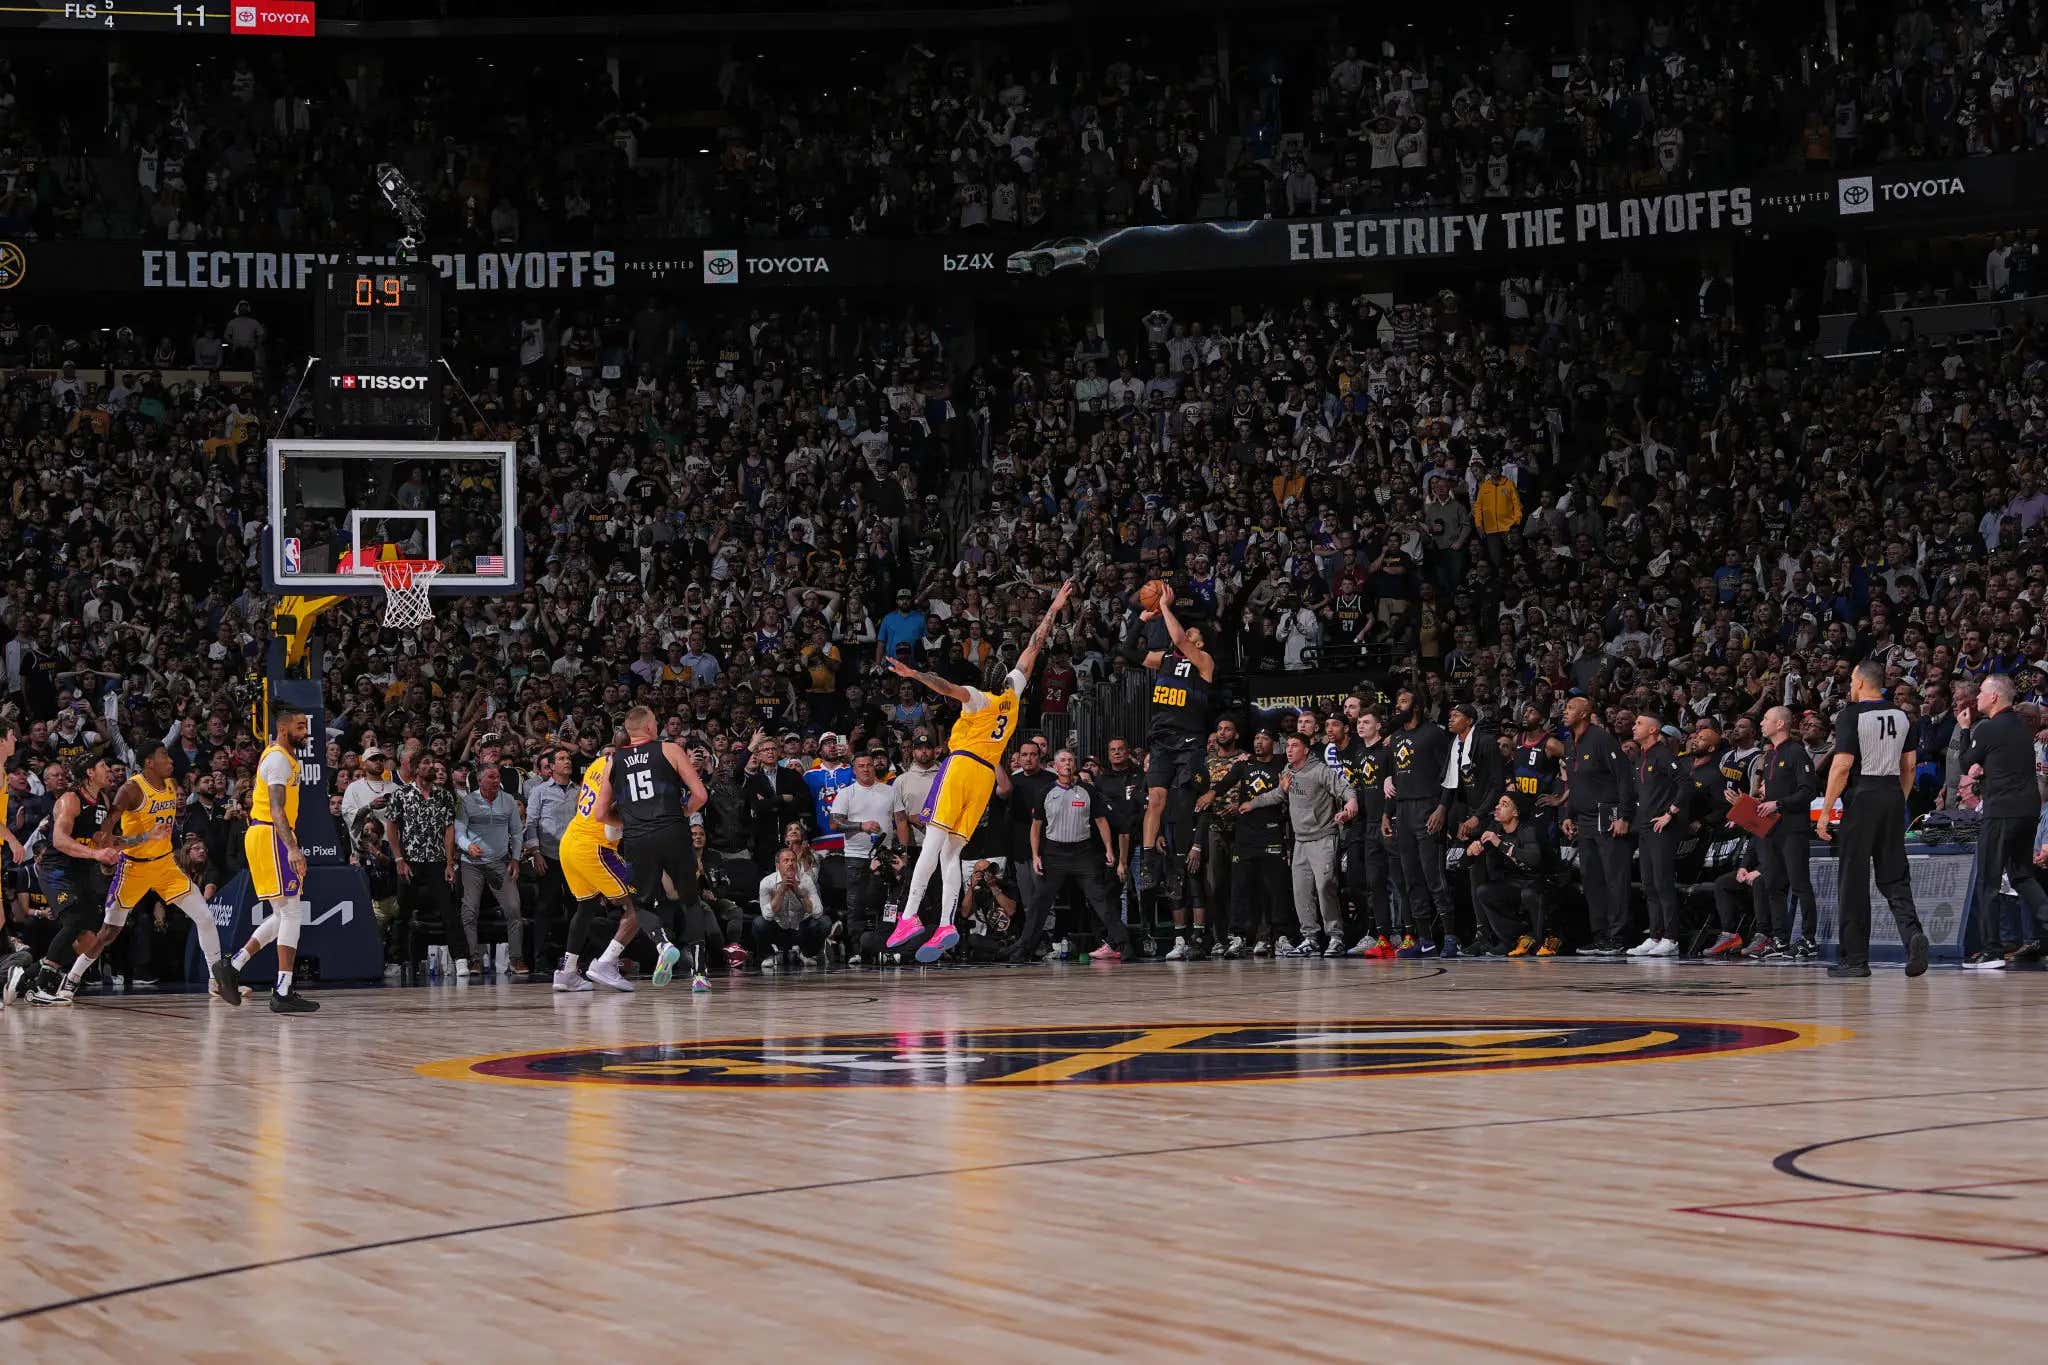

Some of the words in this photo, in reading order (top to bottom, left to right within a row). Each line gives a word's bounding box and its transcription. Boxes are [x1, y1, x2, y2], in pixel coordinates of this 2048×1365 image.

[65, 4, 97, 19] FLS
[173, 4, 205, 27] 1.1
[260, 13, 310, 24] TOYOTA
[104, 15, 115, 28] 4
[1881, 177, 1966, 200] TOYOTA
[1761, 191, 1831, 207] PRESENTED
[1788, 204, 1801, 214] BY
[1287, 213, 1488, 261] ELECTRIFY
[1501, 207, 1566, 249] THE
[1576, 187, 1751, 242] PLAYOFFS
[624, 261, 695, 272] PRESENTED
[746, 257, 831, 274] TOYOTA
[943, 252, 995, 271] bZ4X
[651, 271, 666, 280] BY
[355, 279, 401, 307] 0.9
[358, 375, 428, 390] TISSOT
[1174, 661, 1192, 678] 27
[755, 696, 781, 705] DENVER
[1046, 687, 1064, 702] 24
[1152, 685, 1188, 708] 5280
[991, 714, 1009, 741] 3
[1877, 715, 1897, 740] 74
[1528, 750, 1537, 766] 9
[626, 769, 655, 802] 15
[578, 783, 597, 818] 23
[313, 845, 337, 857] Pixel
